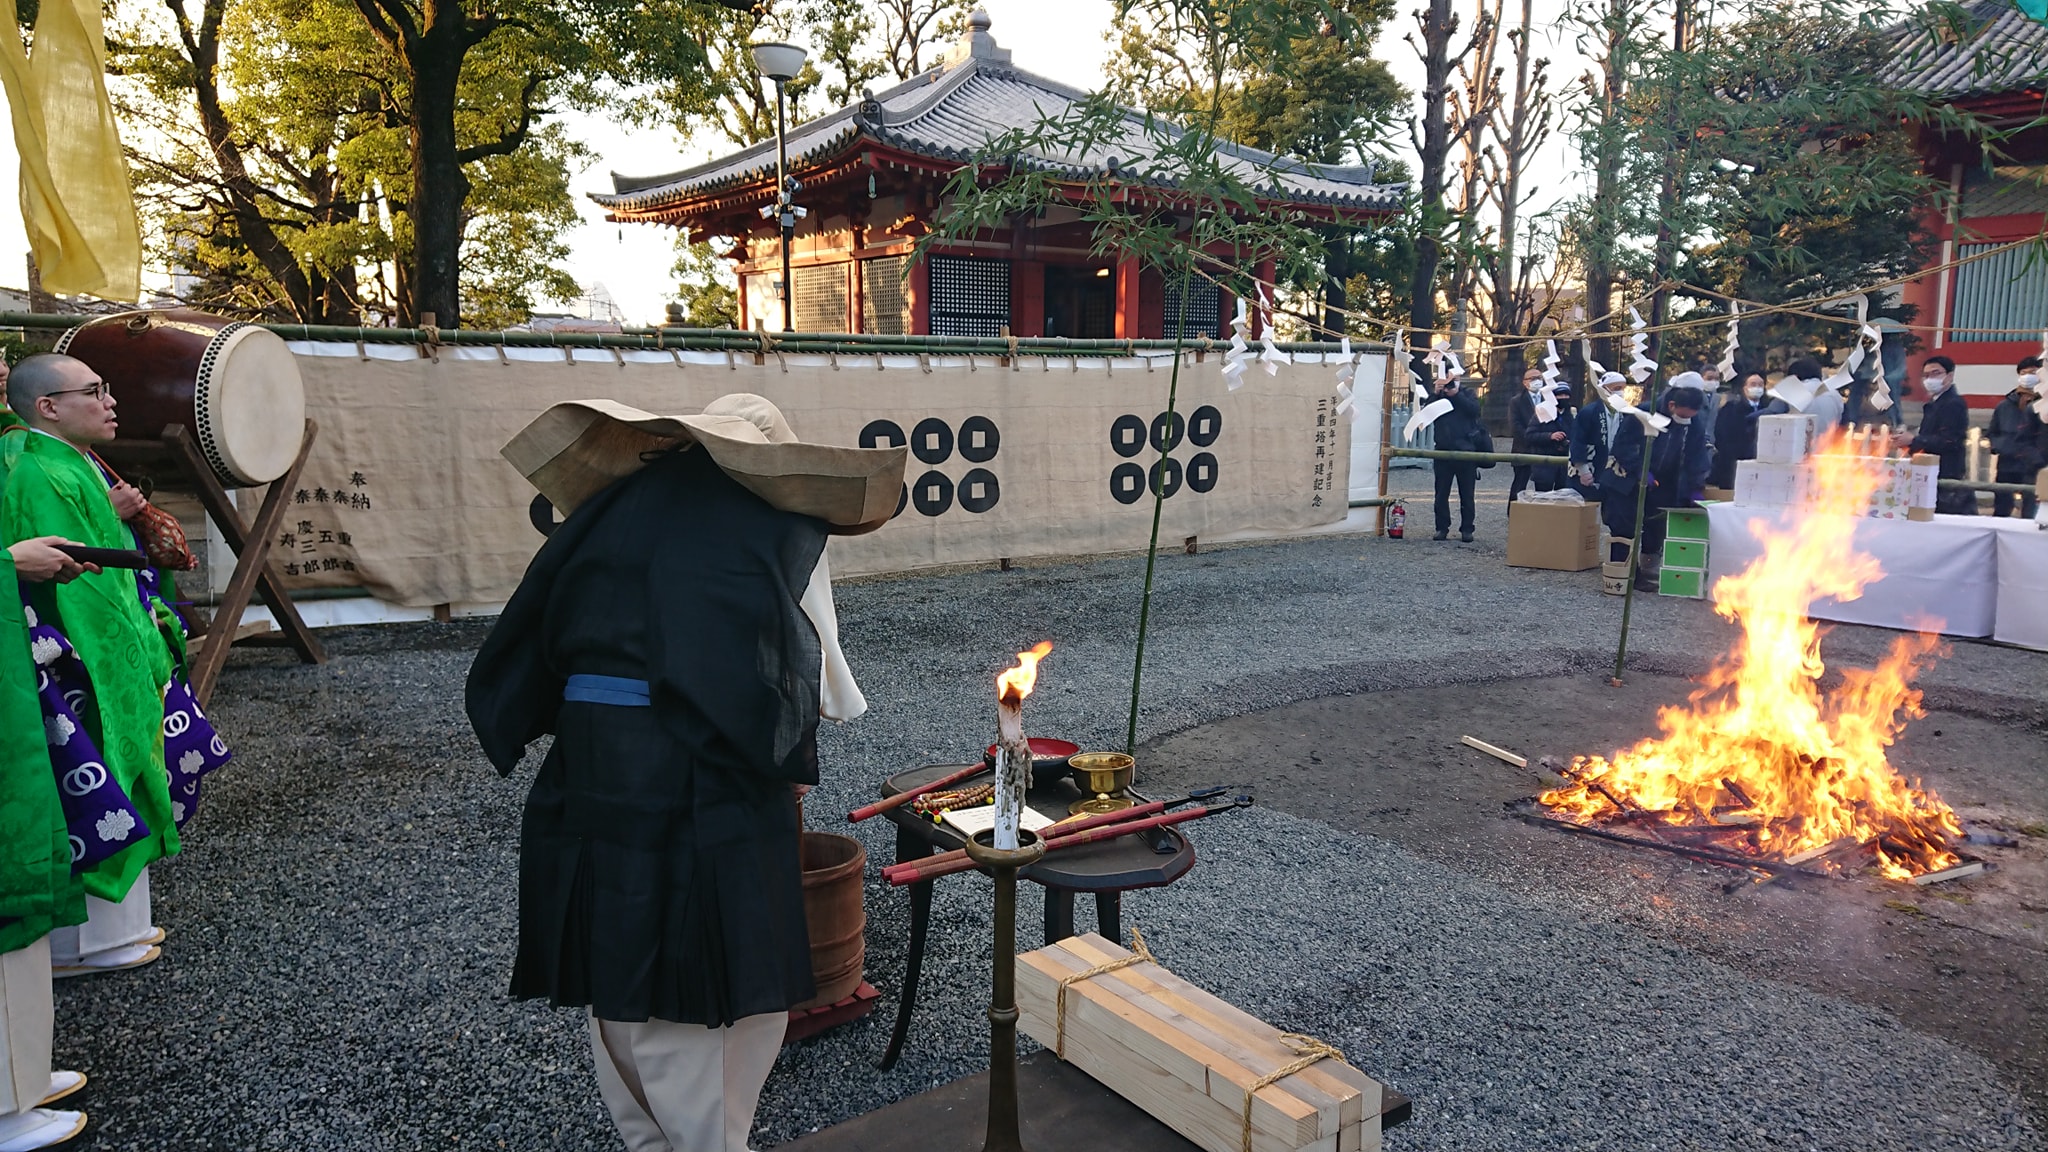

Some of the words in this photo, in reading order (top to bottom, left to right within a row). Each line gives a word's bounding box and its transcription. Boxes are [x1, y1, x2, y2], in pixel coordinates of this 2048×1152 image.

[348, 471, 371, 510] 奉納
[1312, 399, 1327, 508] 三重塔再建記念
